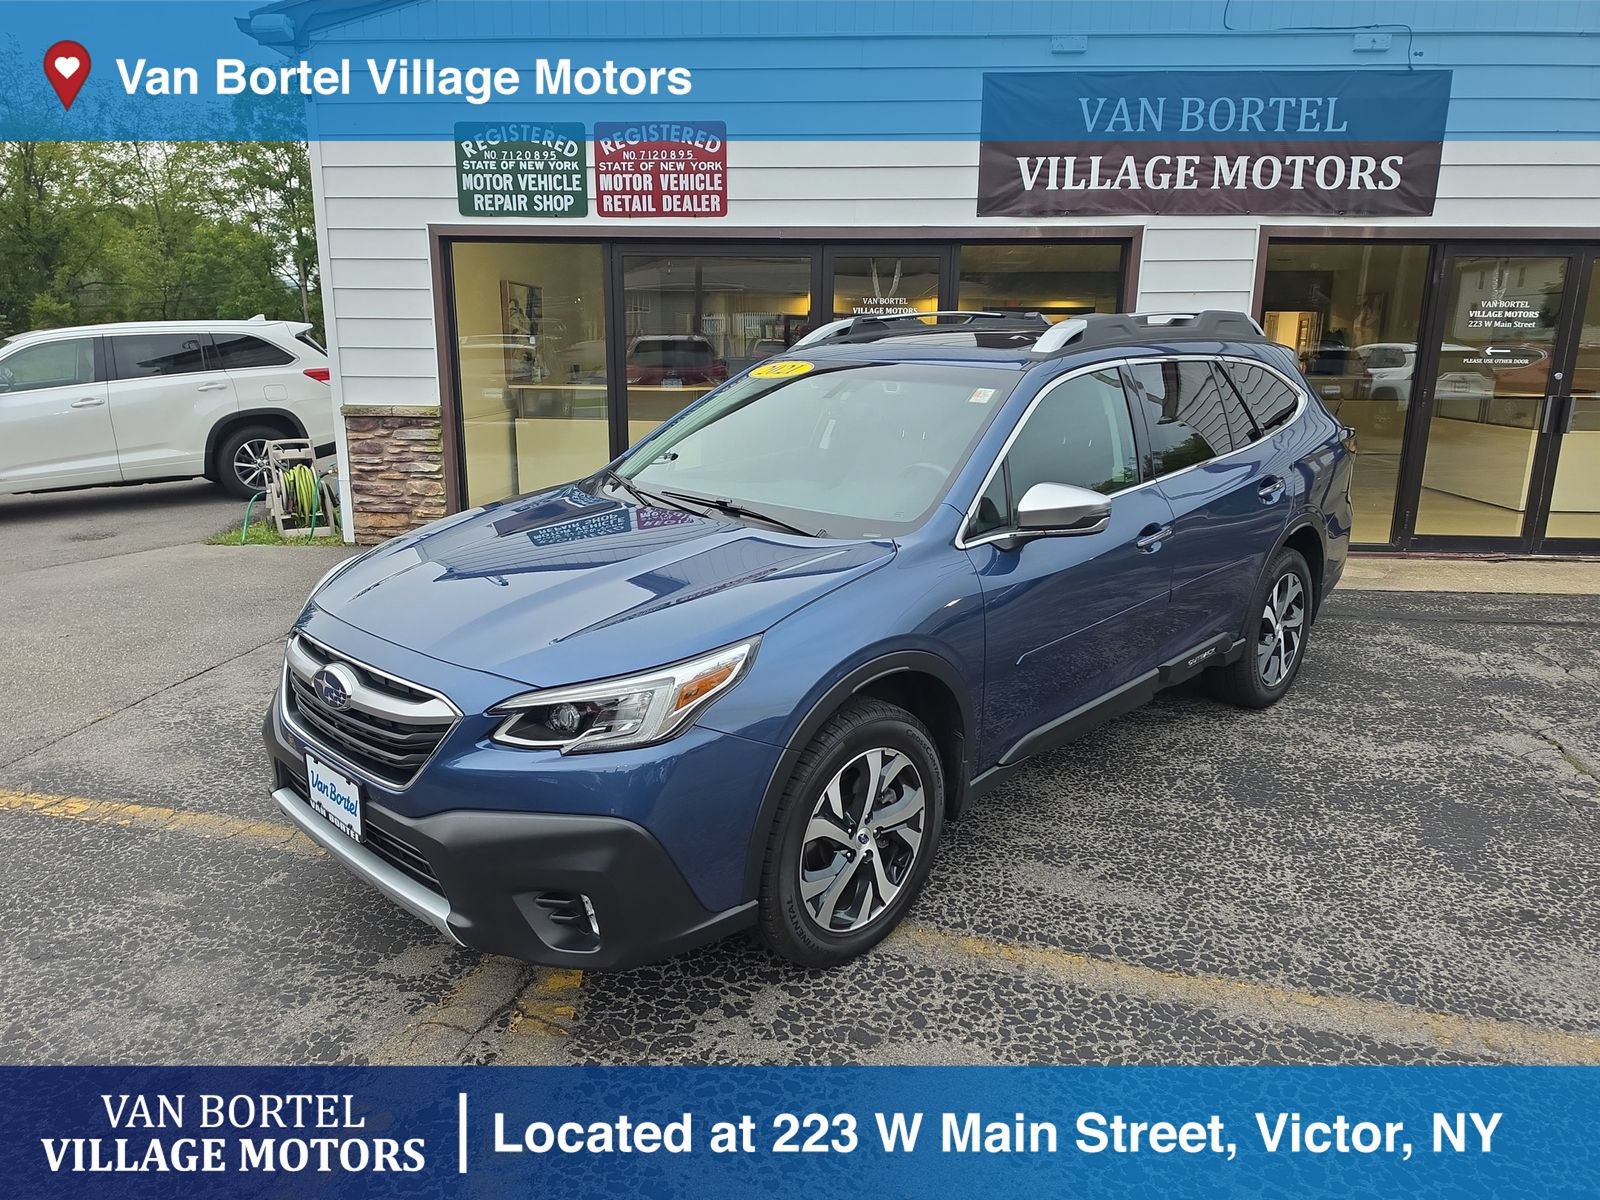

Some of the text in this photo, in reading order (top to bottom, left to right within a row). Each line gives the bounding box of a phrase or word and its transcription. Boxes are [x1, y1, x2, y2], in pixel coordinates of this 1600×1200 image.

[1078, 97, 1348, 133] VAN BORTEL
[461, 124, 578, 158] REGISTERED
[600, 124, 721, 156] REGISTERED
[463, 160, 579, 170] STATE OF NEW YORK
[599, 161, 722, 171] STATE OF NEW YORK
[1016, 155, 1404, 192] VILLAGE MOTORS
[462, 173, 582, 191] MOTOR VEHICLE
[599, 173, 722, 191] MOTOR VEHICLE
[473, 194, 575, 211] REPAIR SHOP
[603, 194, 721, 212] RETAIL DEALER
[862, 297, 908, 305] VAN BORTEL
[1481, 300, 1530, 309] VAN BORTEL
[1469, 310, 1540, 318] VILLAGE MOTORS
[1468, 320, 1536, 328] 223 W Main Street
